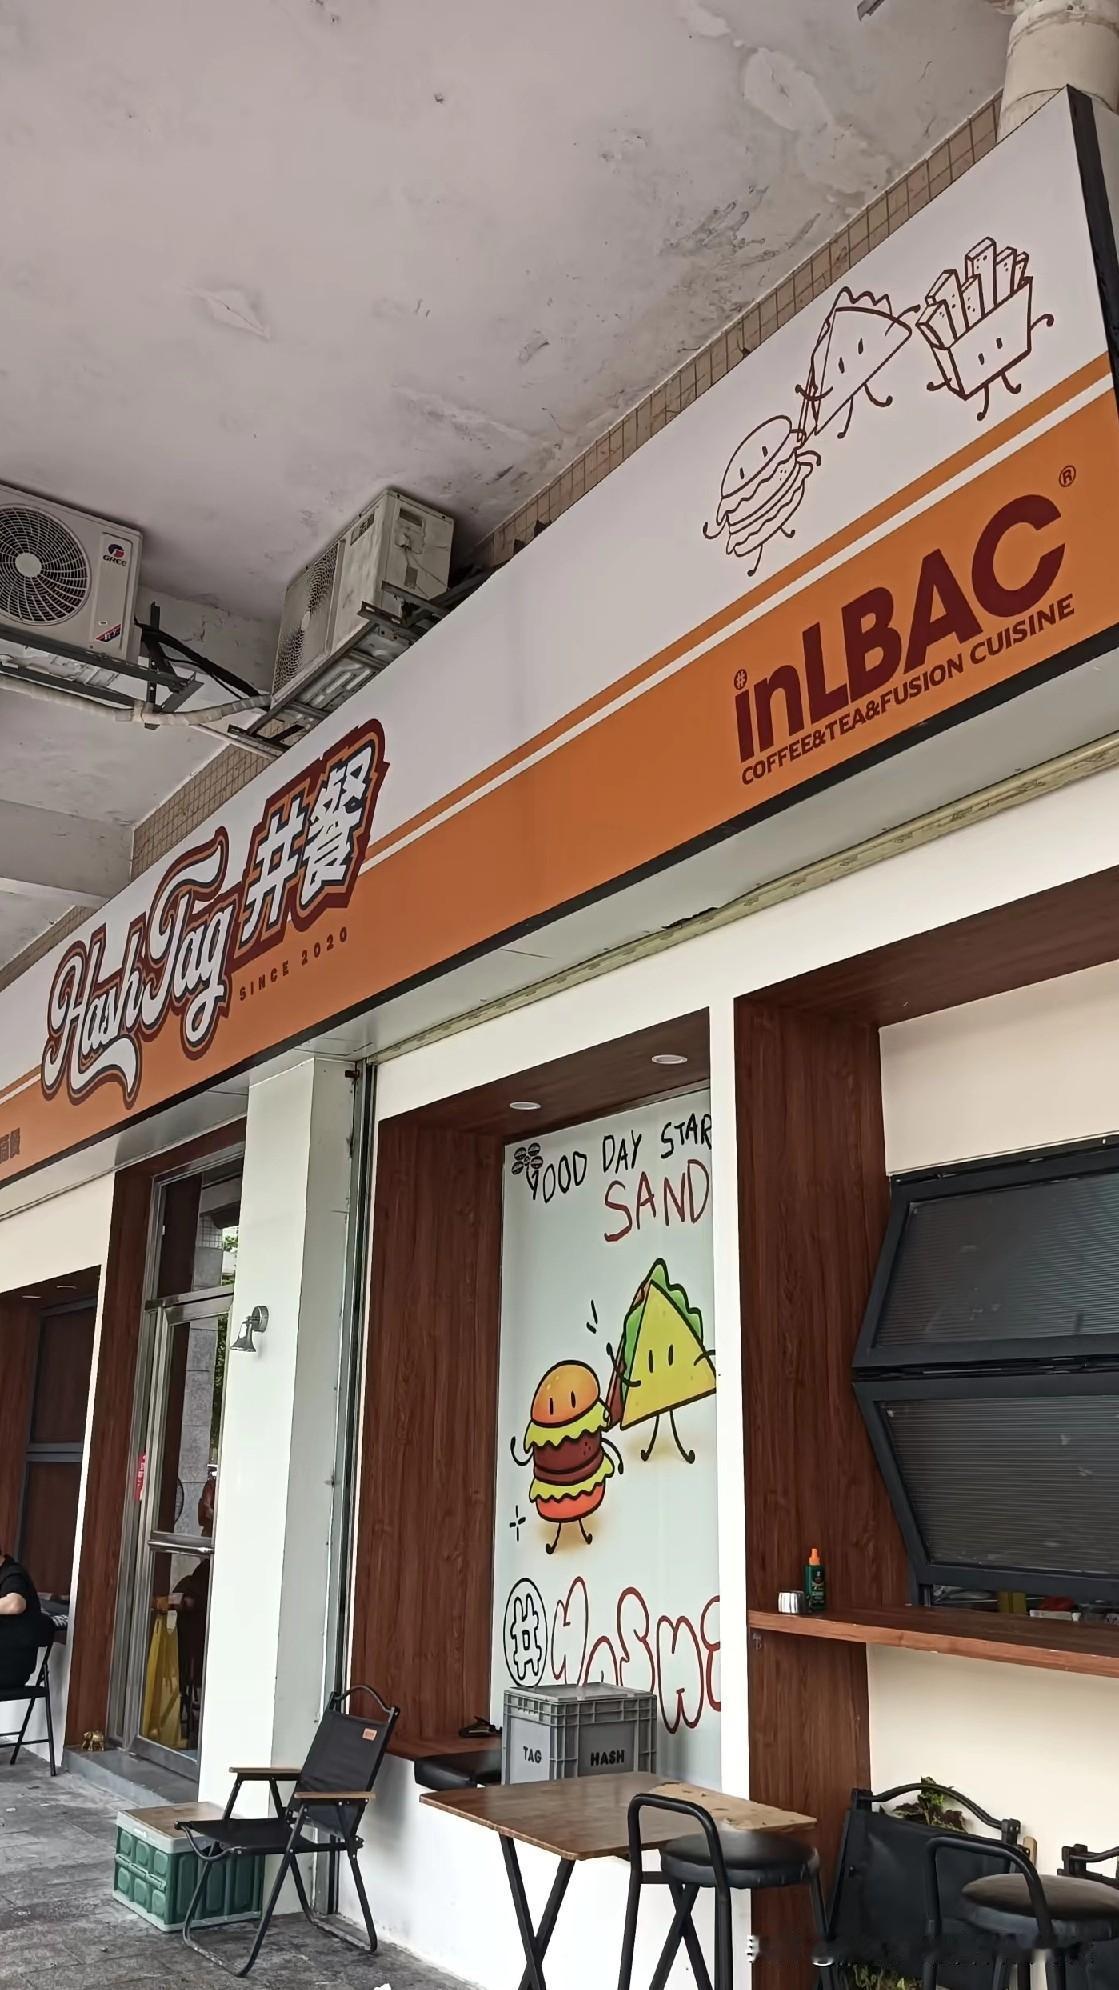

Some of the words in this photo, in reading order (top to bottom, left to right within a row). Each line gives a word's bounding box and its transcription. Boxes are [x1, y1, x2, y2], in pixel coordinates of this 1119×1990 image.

[741, 653, 965, 786] COFFEE&TEA&FUSION
[969, 593, 1075, 665] CUISINE
[239, 960, 289, 1001] SINCE
[301, 926, 347, 966] 2020
[602, 1130, 642, 1174] DAY
[604, 1158, 711, 1242] SAND
[523, 1746, 542, 1763] TAG
[590, 1750, 625, 1766] HASH
